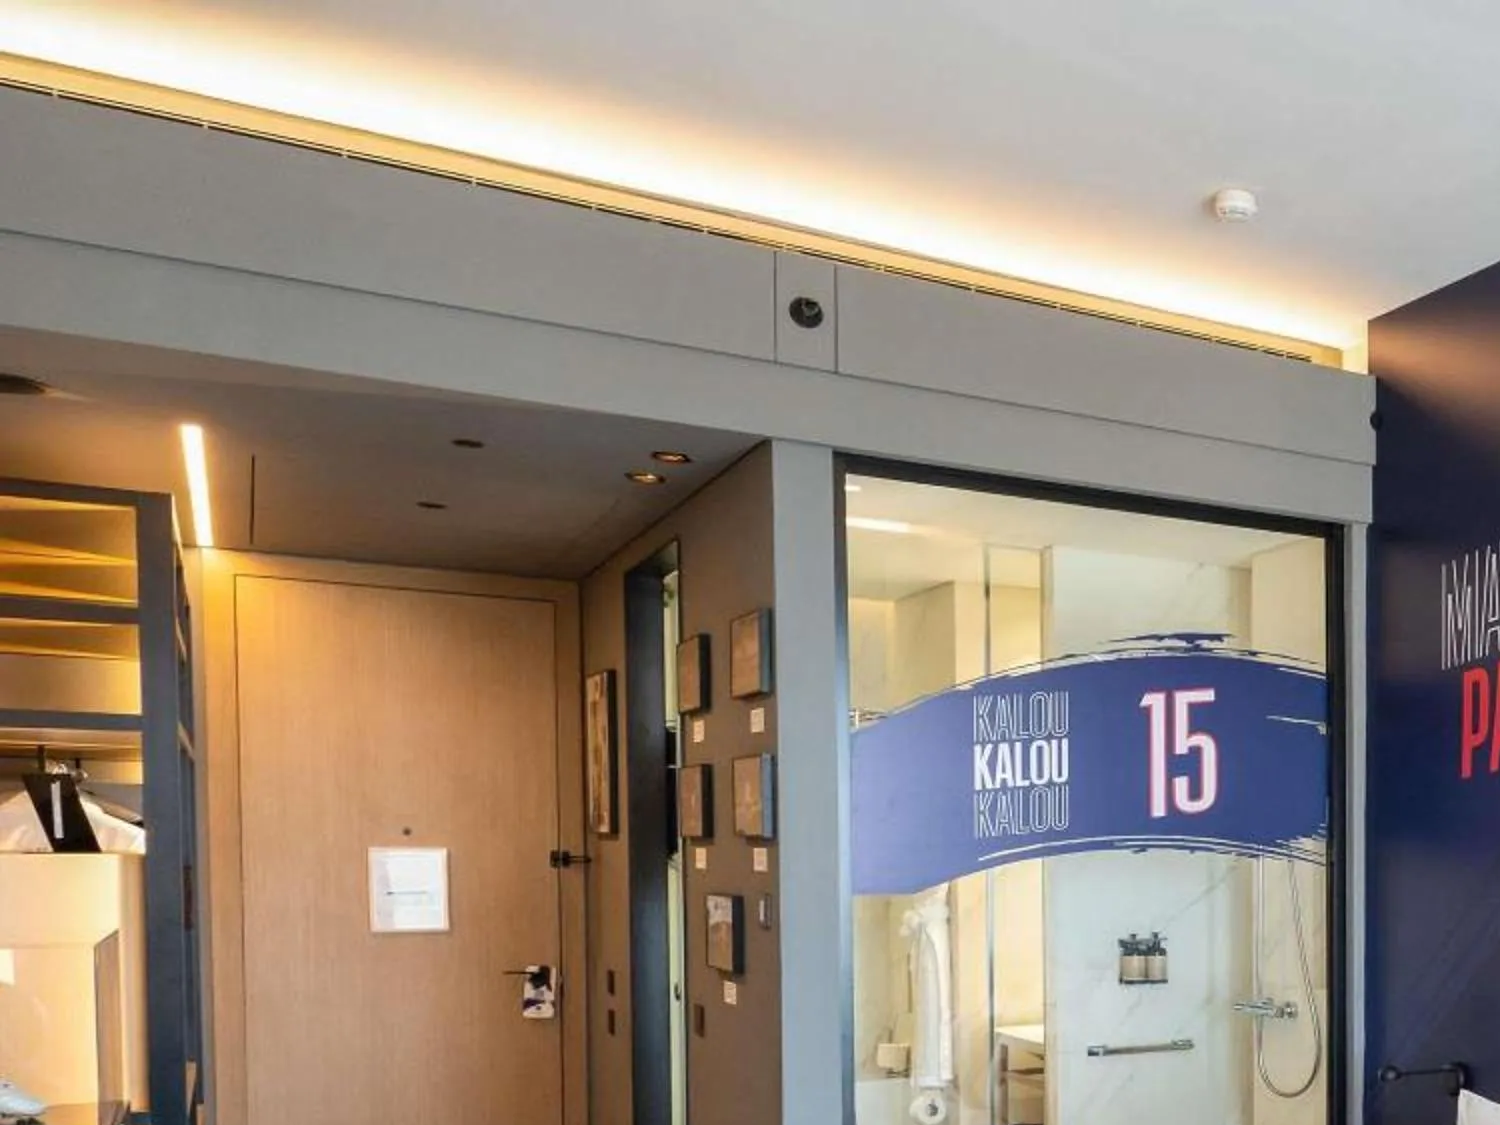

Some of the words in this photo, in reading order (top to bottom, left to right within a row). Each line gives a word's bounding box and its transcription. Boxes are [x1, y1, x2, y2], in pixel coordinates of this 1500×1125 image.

[973, 691, 1069, 741] KALOU
[973, 739, 1069, 790] KALOU
[1139, 687, 1219, 818] 15
[973, 784, 1069, 839] KALOU
